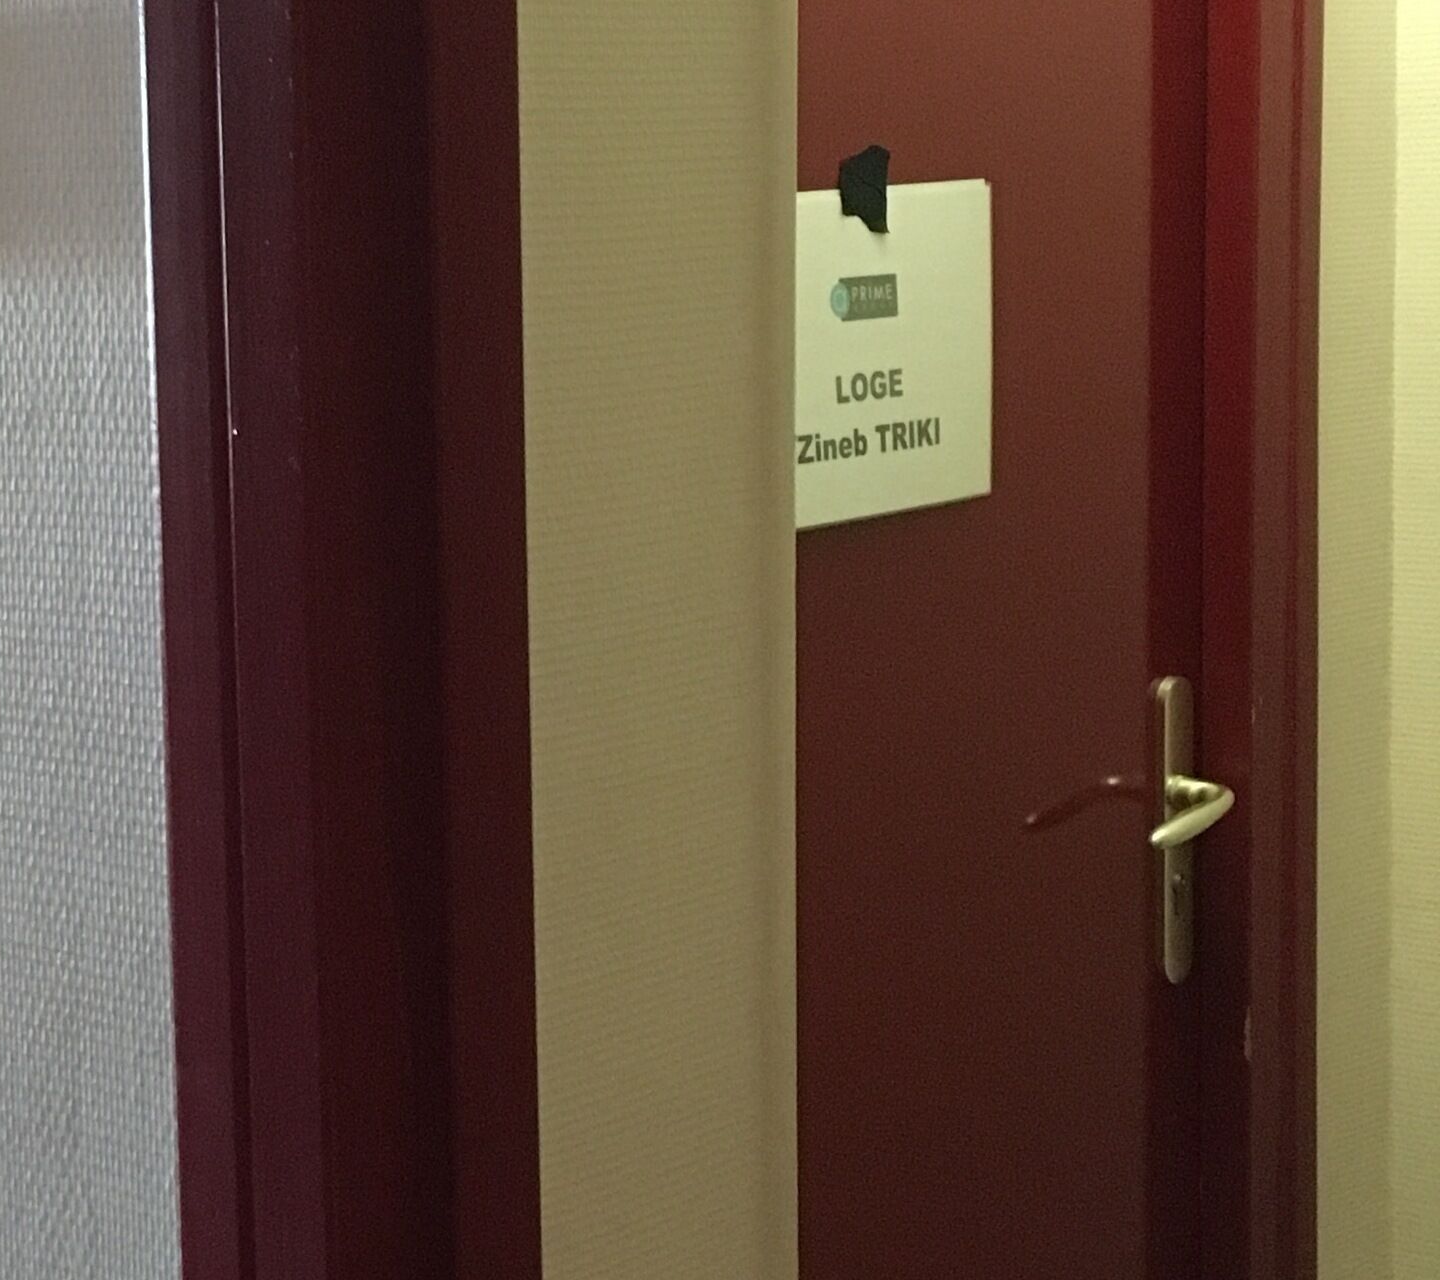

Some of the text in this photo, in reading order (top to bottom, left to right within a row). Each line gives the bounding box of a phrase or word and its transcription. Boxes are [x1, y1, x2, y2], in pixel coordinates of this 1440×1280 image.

[851, 283, 893, 301] PRIME
[836, 368, 903, 404] LOGE
[796, 417, 941, 465] Zineb TRIKI
